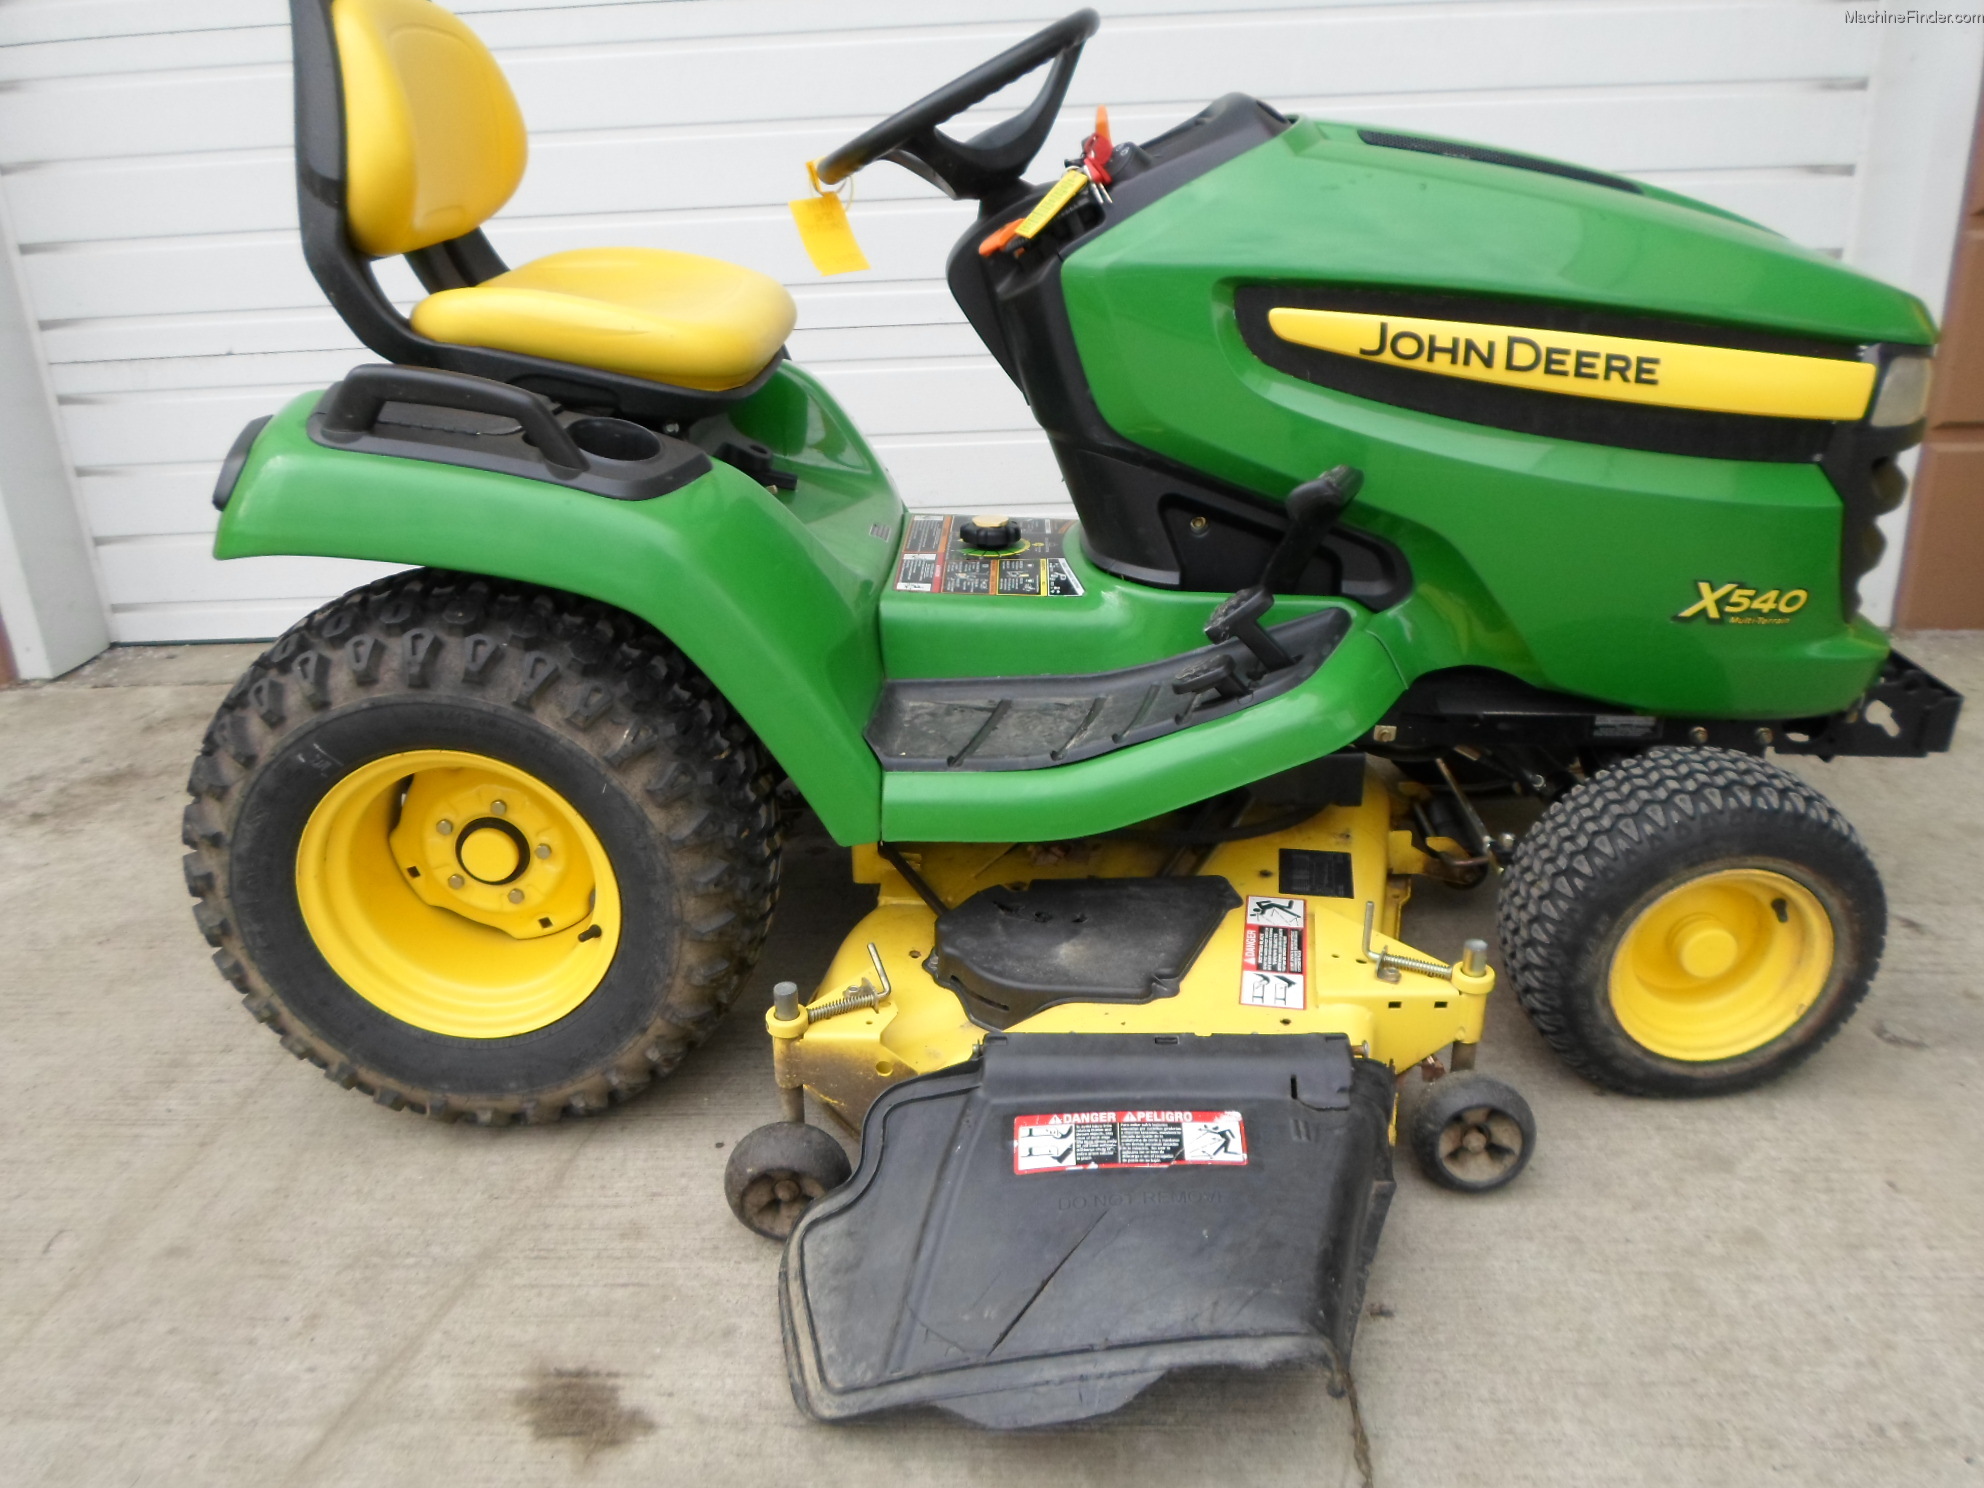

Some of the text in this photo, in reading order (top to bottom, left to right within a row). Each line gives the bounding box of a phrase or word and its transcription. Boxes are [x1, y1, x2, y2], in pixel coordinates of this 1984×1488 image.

[1359, 321, 1661, 386] JOHN DEERE
[1677, 581, 1809, 618] X540
[1244, 929, 1256, 959] DANGER
[1063, 1112, 1116, 1123] DANGER
[1137, 1110, 1193, 1123] PELIGRO
[1058, 1195, 1087, 1211] DO
[1094, 1191, 1132, 1208] NOT
